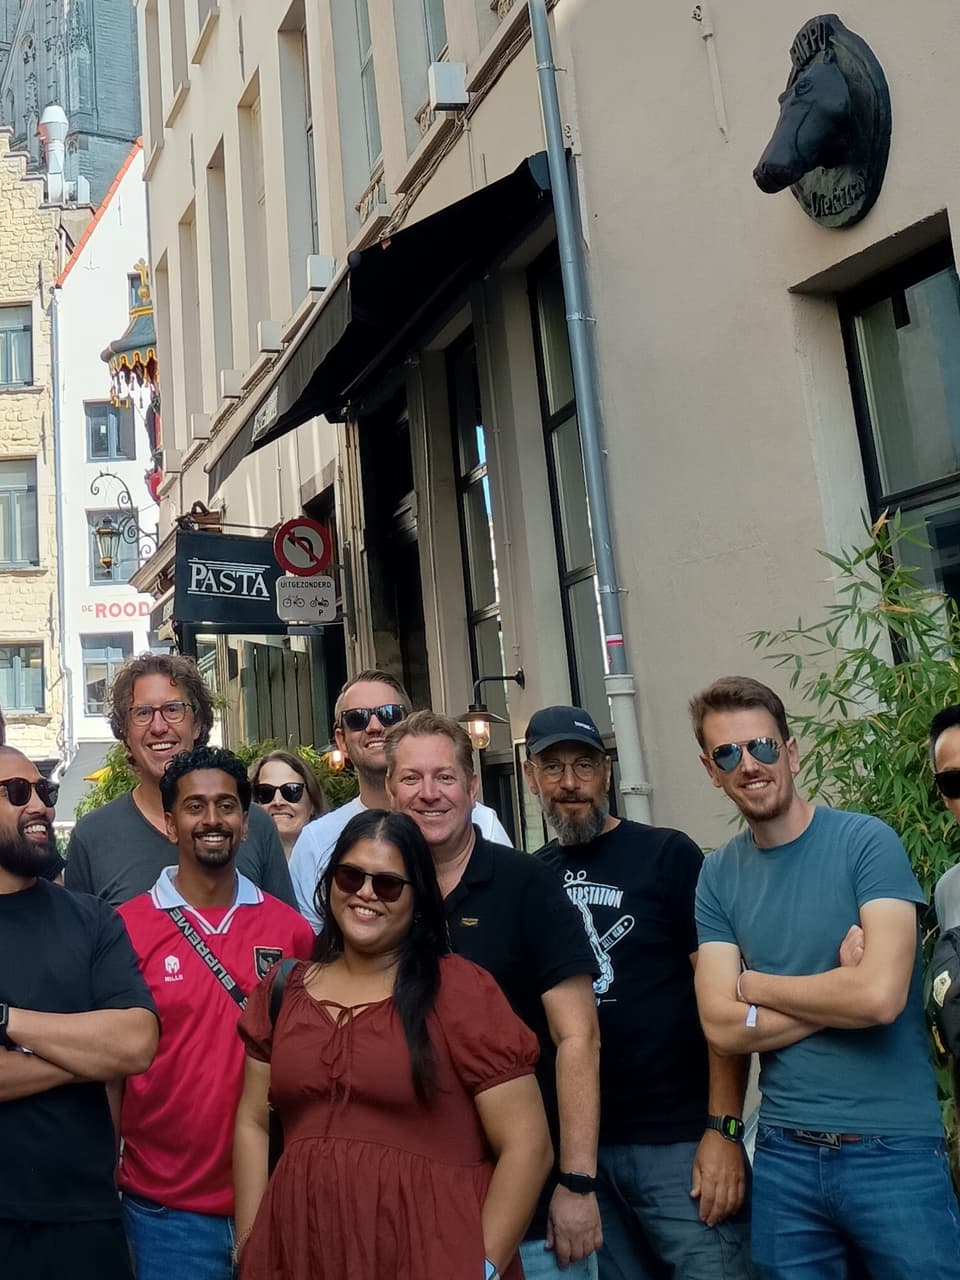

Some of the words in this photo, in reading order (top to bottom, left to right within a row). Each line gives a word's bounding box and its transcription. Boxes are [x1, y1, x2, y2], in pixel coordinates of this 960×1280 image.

[187, 563, 270, 597] PASTA
[280, 581, 332, 589] UITGEZONDERD
[81, 605, 94, 613] DE
[318, 609, 324, 617] P
[170, 908, 236, 990] SUPREME
